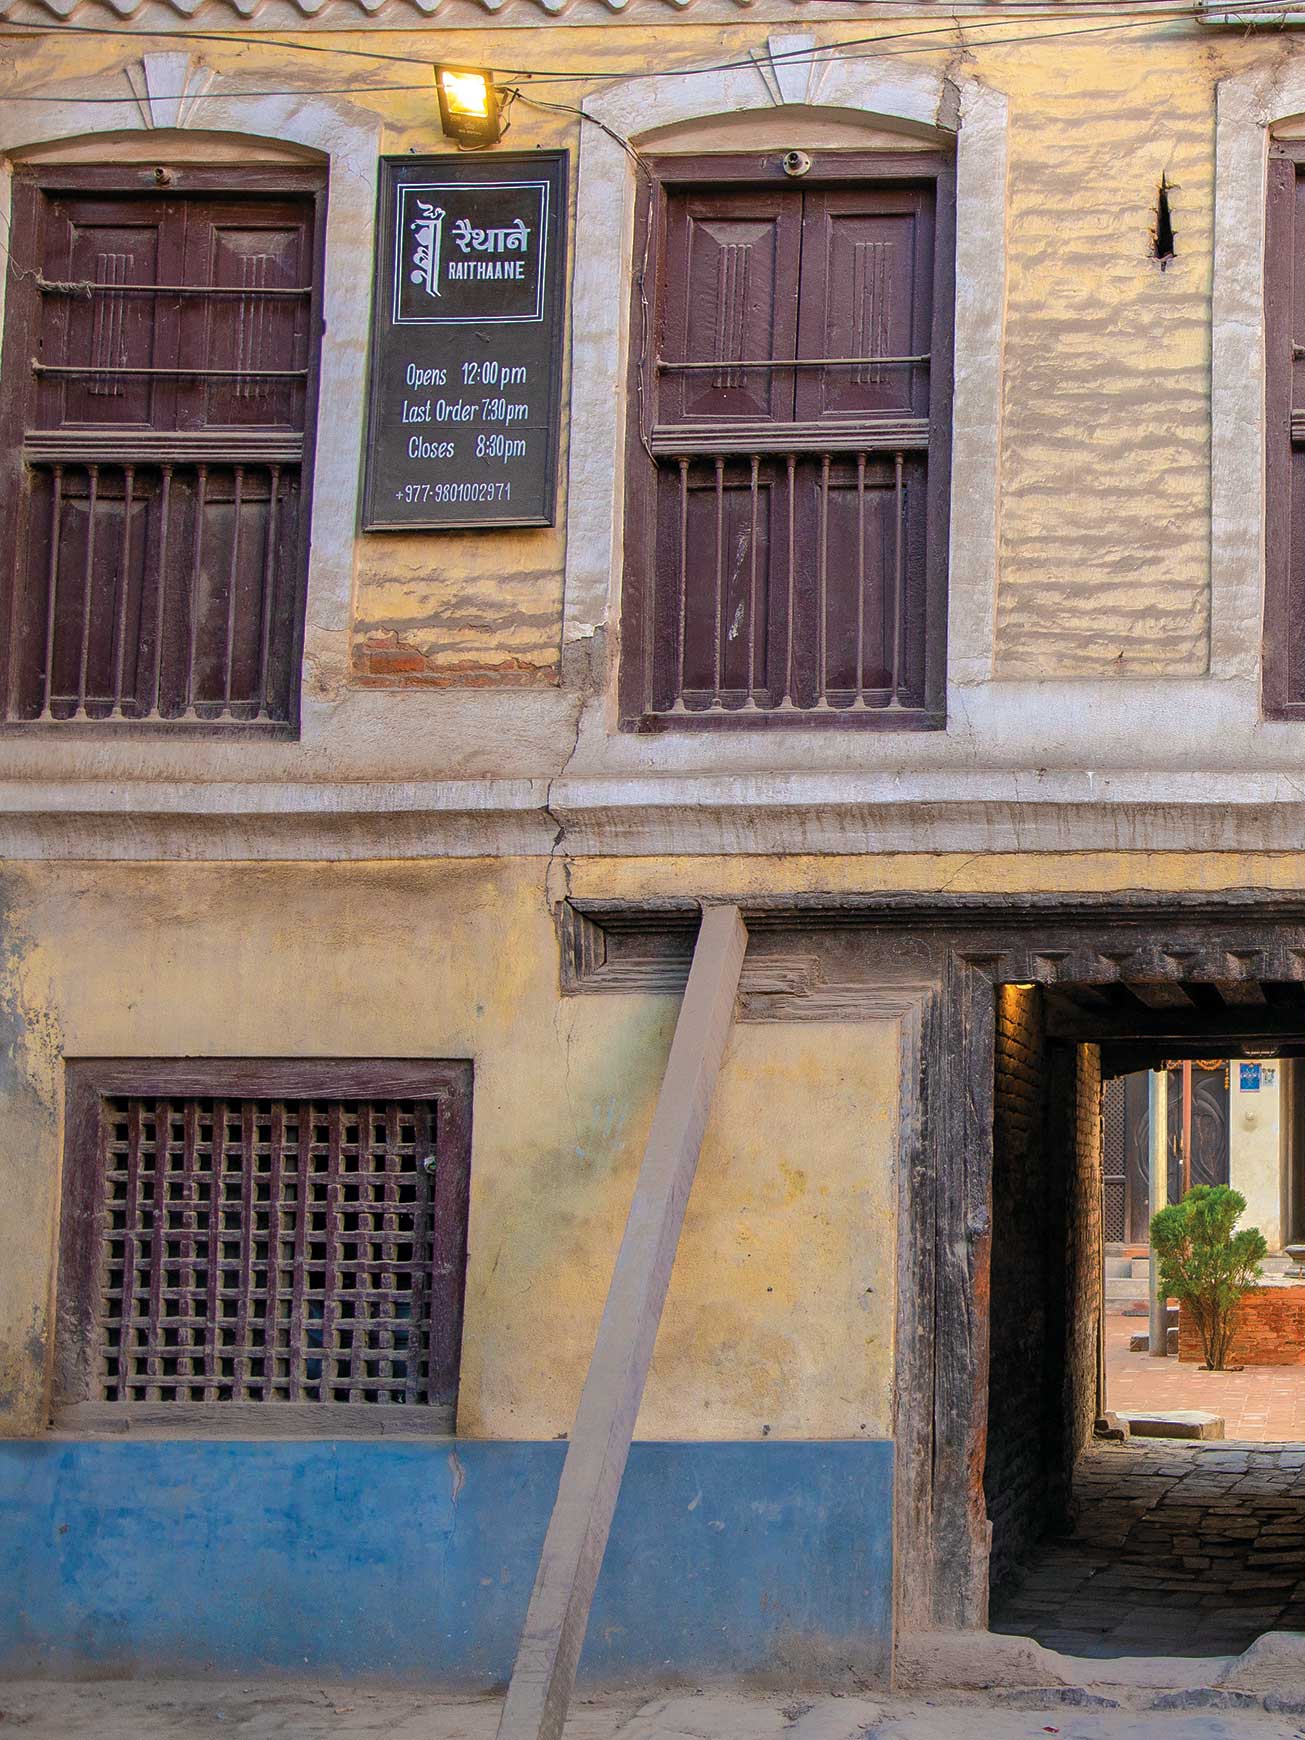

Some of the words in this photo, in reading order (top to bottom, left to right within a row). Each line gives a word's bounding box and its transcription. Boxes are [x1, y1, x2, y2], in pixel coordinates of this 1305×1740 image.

[451, 218, 531, 253] रैथाने
[448, 261, 525, 280] RAITHAANE
[406, 363, 447, 390] Opens
[402, 400, 432, 423] Last
[436, 399, 479, 422] Order
[408, 436, 455, 458] Closes
[476, 434, 526, 464] 8:30pm
[395, 482, 511, 503] +977-9801002971
